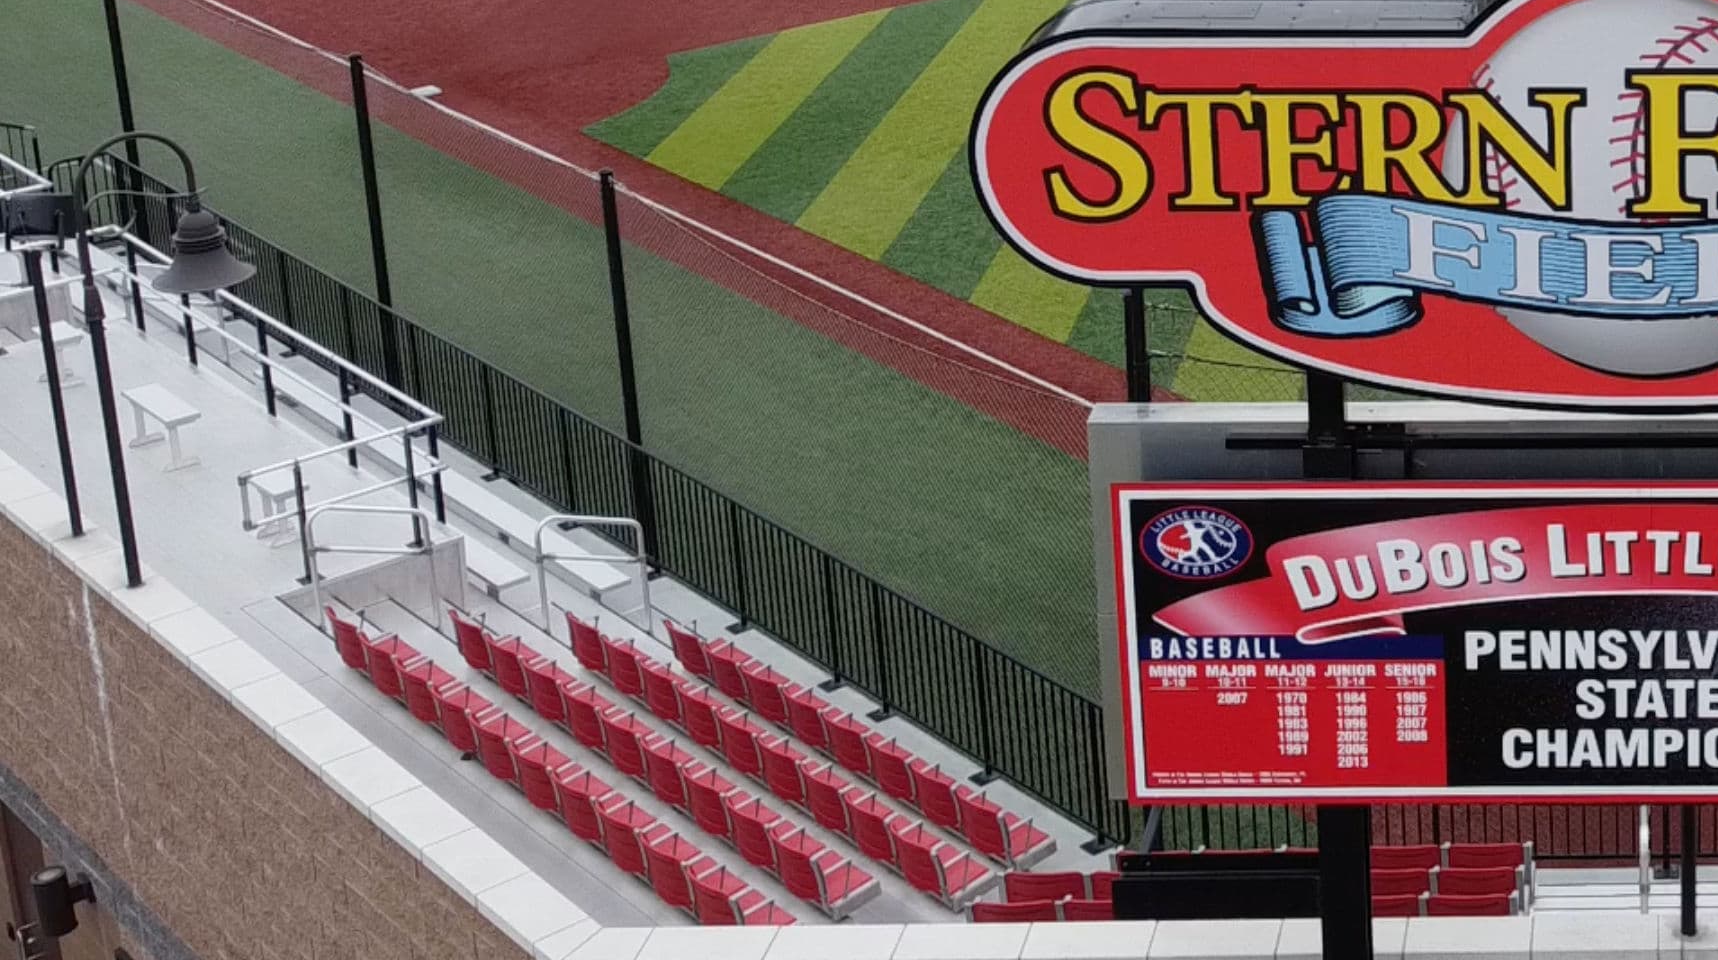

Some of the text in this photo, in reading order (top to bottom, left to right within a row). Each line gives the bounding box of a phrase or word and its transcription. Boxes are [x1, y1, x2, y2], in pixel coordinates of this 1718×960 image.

[1041, 64, 1588, 222] STERN
[1150, 509, 1242, 533] LITTLE LEAGUE
[1161, 557, 1240, 576] BASEBALL
[1149, 637, 1281, 659] BASEBALL
[1149, 665, 1197, 678] MINOR
[1205, 664, 1257, 678] MAJOR
[1264, 664, 1316, 678] MAJOR
[1324, 664, 1376, 678] JUNIOR
[1384, 664, 1437, 677] SENIOR
[1337, 756, 1369, 768] 2013
